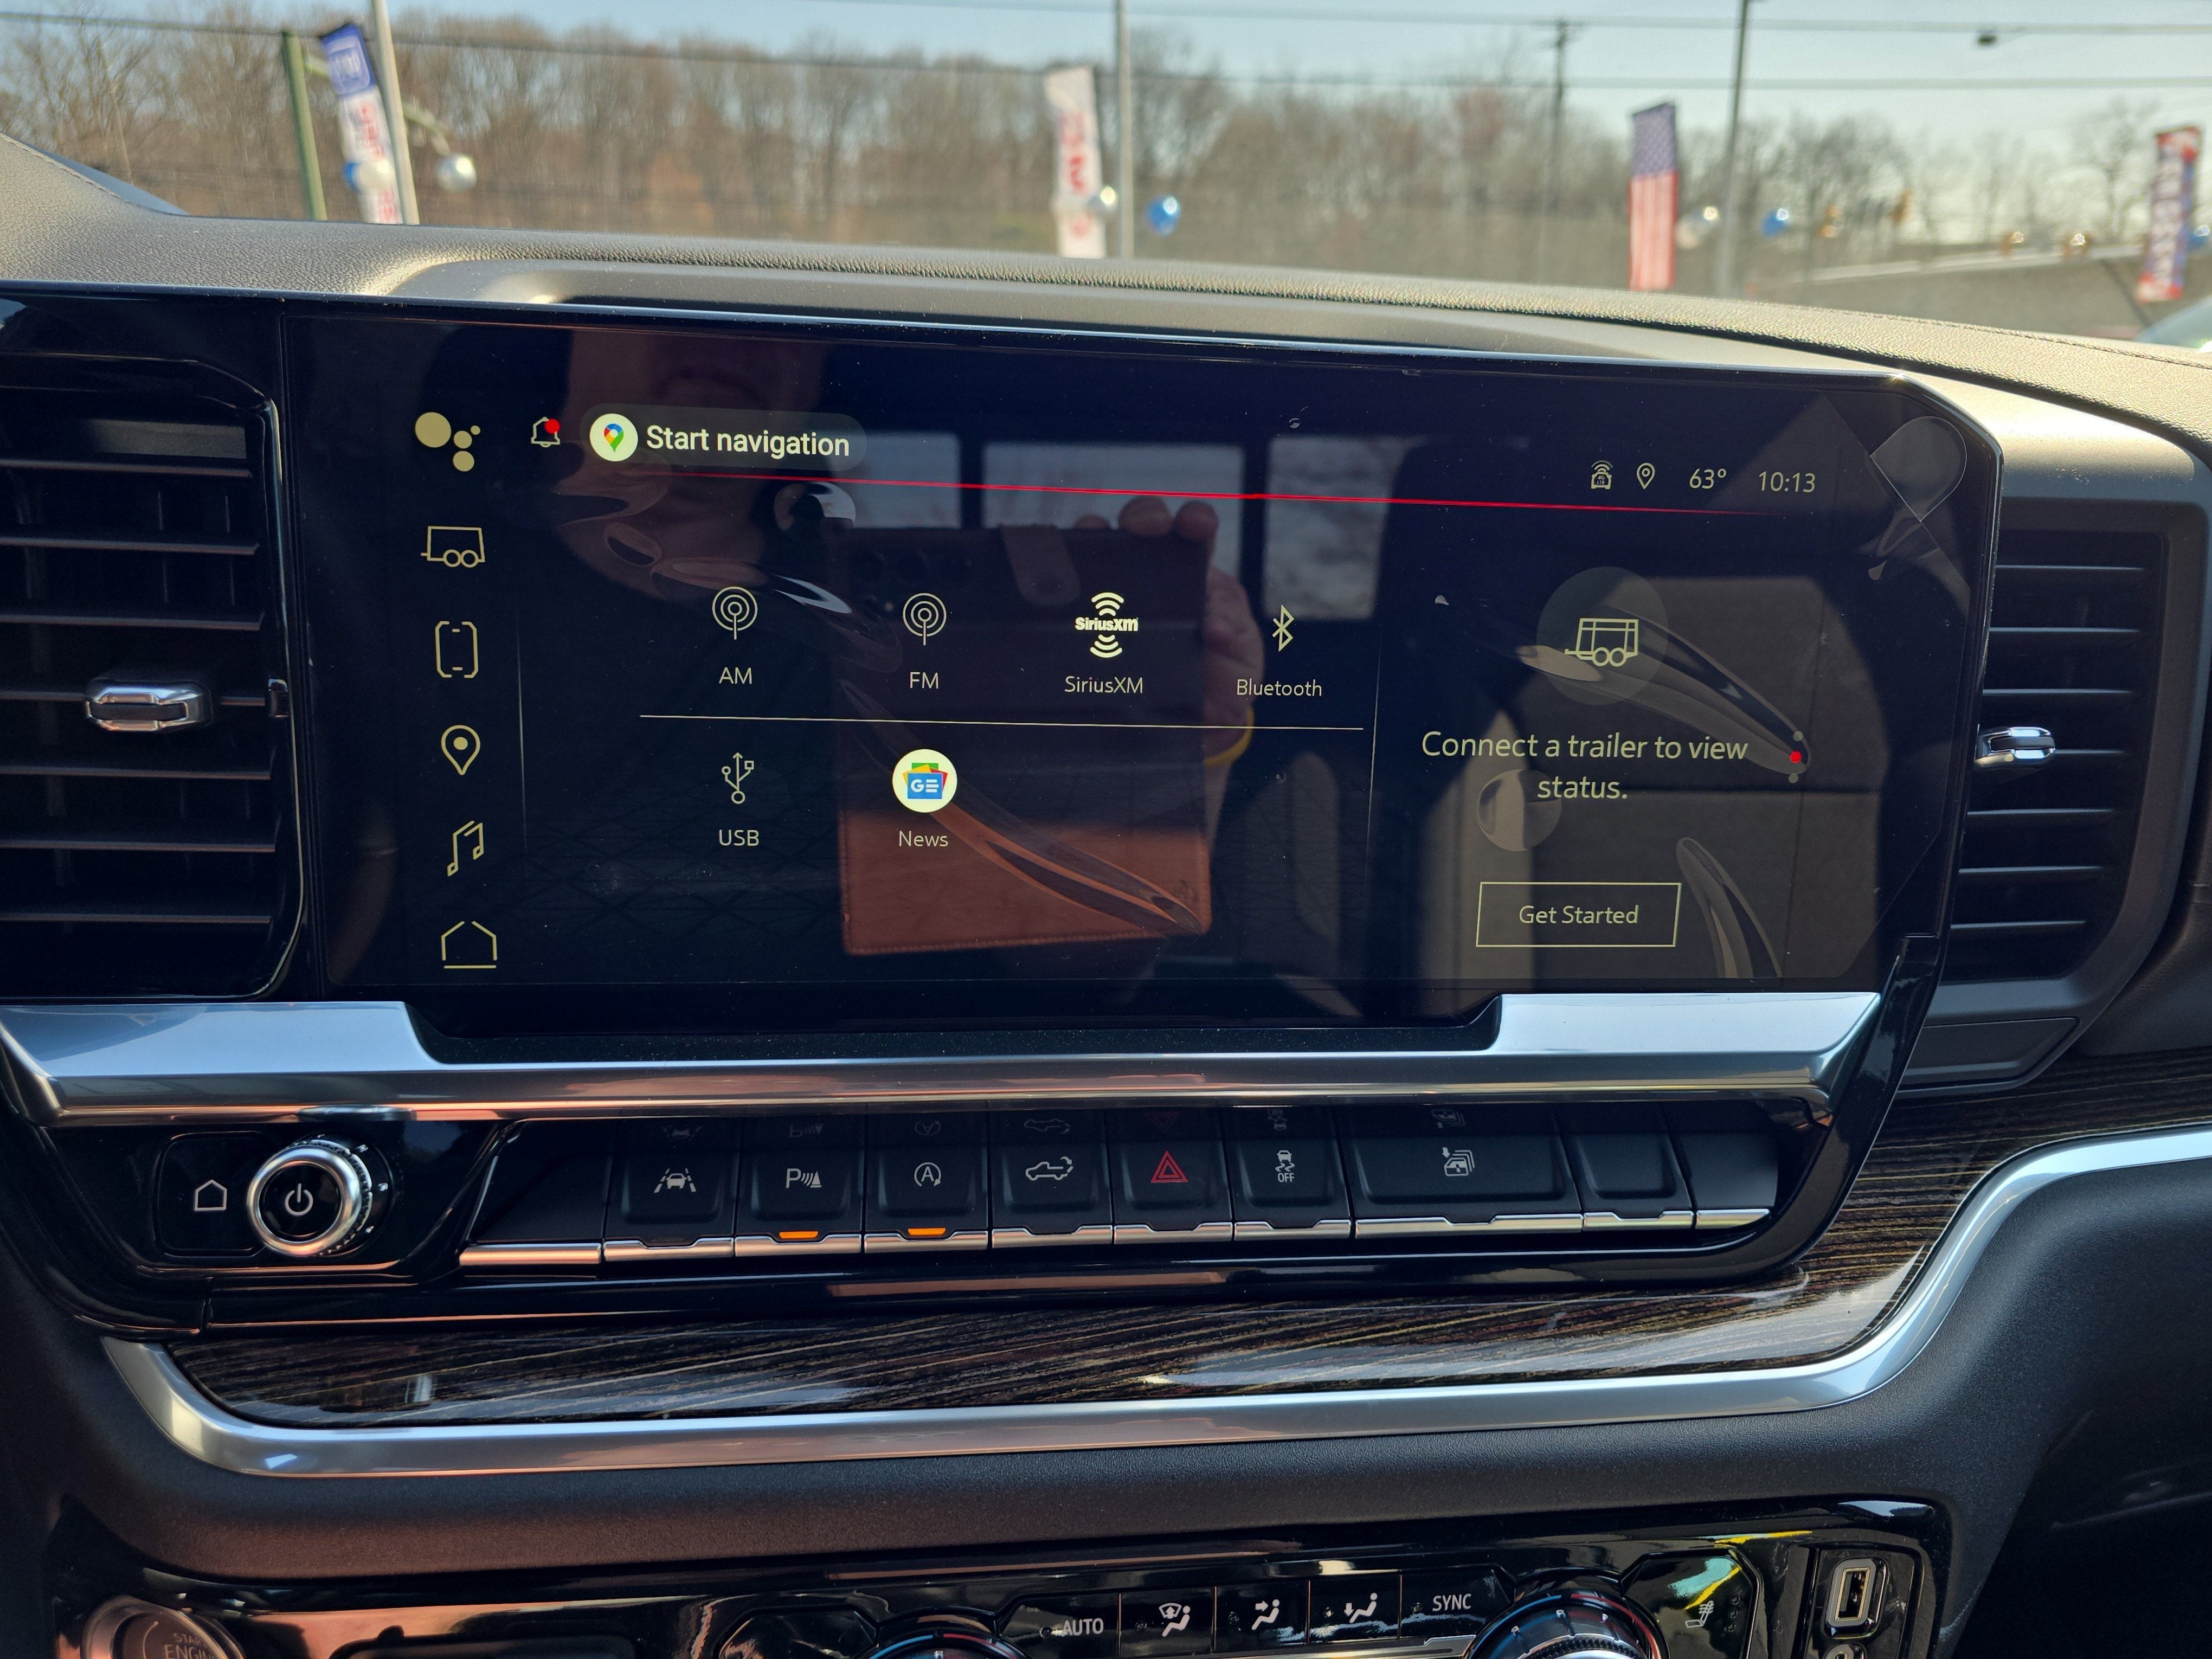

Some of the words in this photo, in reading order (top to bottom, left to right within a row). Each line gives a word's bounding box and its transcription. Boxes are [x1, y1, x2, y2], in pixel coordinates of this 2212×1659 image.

[646, 425, 710, 451] Start
[717, 429, 850, 460] navigation
[1689, 468, 1727, 489] 63°
[1759, 471, 1815, 493] 10:13
[719, 667, 753, 685] AM
[909, 672, 939, 689] FM
[1064, 676, 1143, 694] SiriusXM
[1237, 678, 1322, 697] Bluetooth
[1422, 730, 1538, 757] Connect
[1545, 739, 1560, 757] a
[1567, 731, 1647, 759] trailer
[1654, 736, 1682, 759] to
[1688, 735, 1749, 760] view
[1536, 775, 1628, 799] status.
[718, 828, 760, 847] USB
[898, 830, 949, 847] News
[1519, 904, 1557, 924] Get
[1561, 904, 1639, 924] Started
[1277, 1172, 1295, 1183] OFF
[1432, 1593, 1472, 1612] SYNC
[1062, 1617, 1104, 1637] AUTO
